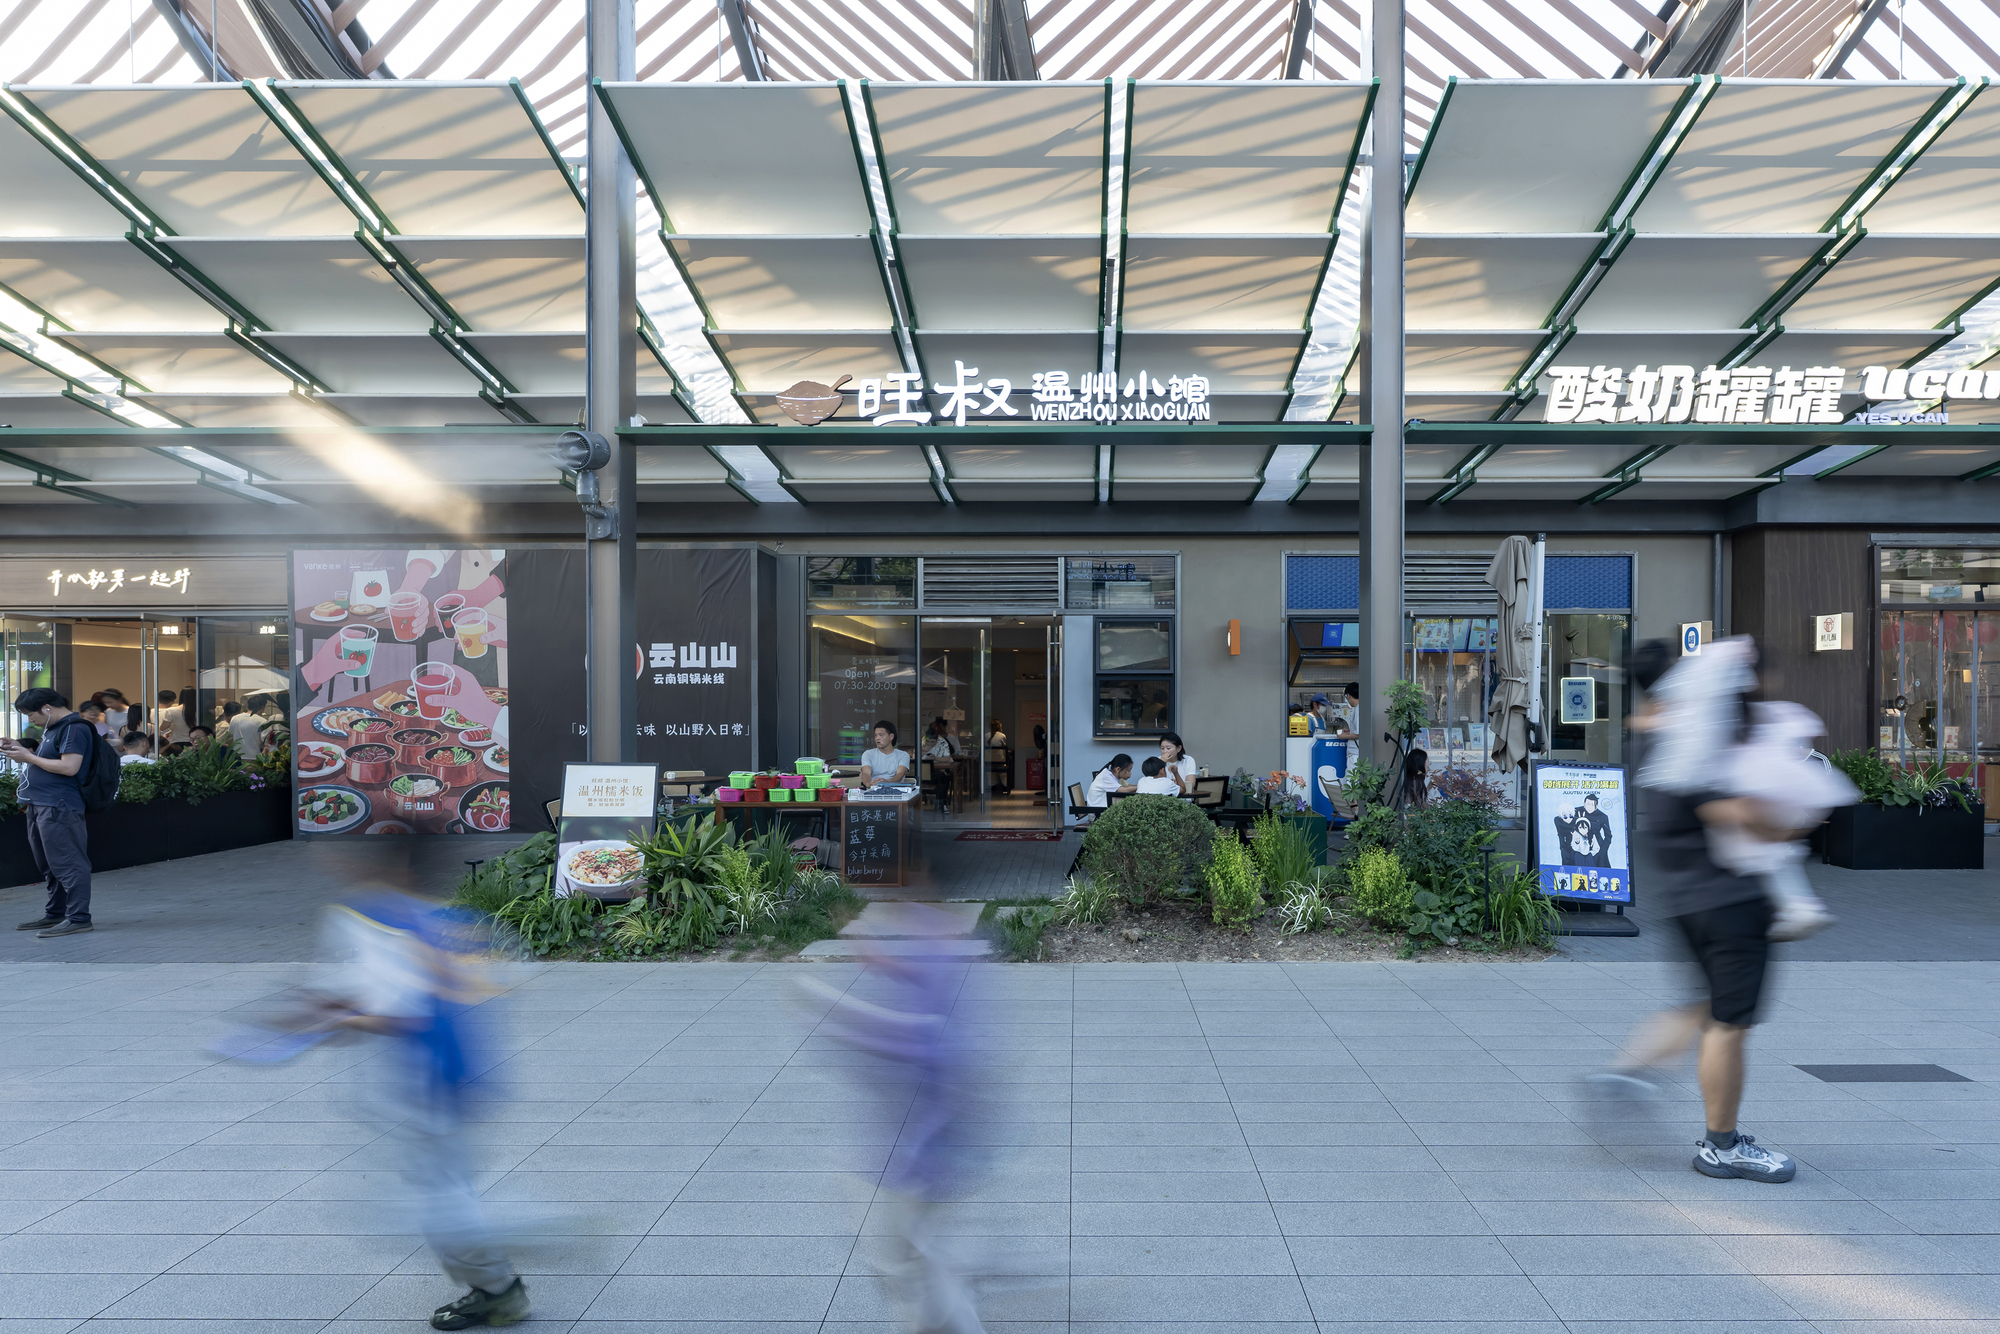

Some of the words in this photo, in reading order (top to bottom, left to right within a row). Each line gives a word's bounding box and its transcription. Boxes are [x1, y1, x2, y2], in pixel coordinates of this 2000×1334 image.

[857, 360, 1019, 427] 旺叔
[1031, 371, 1210, 403] 温州小馆
[1543, 364, 1846, 424] 酸奶罐罐
[1030, 403, 1117, 422] WENZHOU
[1121, 402, 1210, 421] XIAOGUAN
[1855, 412, 1892, 425] YES
[648, 641, 737, 669] 云山山
[653, 672, 725, 685] 云南铜锅米线
[845, 669, 869, 680] Open
[833, 680, 897, 691] 07:30-20:00
[578, 785, 643, 797] 温州糯米饭
[850, 809, 897, 823] 自家基地
